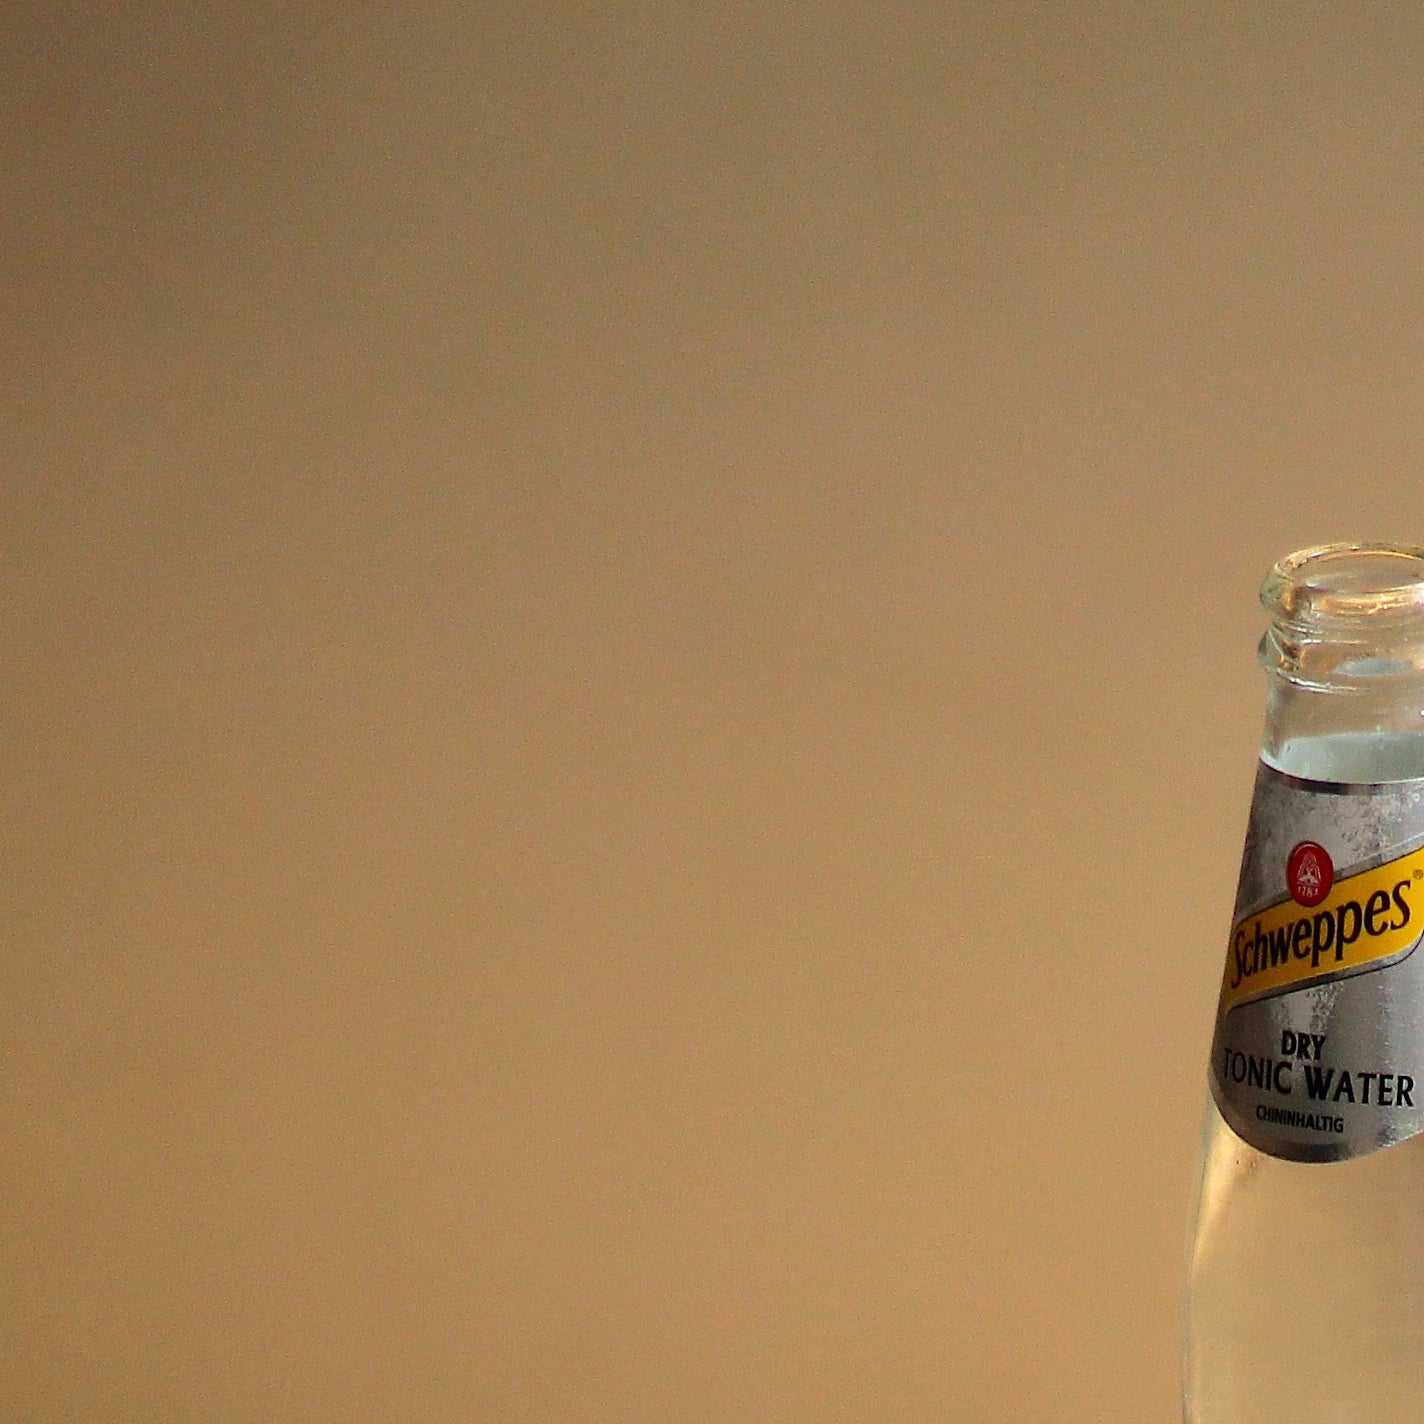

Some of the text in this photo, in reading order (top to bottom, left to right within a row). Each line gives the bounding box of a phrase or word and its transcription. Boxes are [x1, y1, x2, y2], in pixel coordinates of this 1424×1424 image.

[1231, 880, 1412, 989] Schweppes
[1281, 1030, 1326, 1060] DRY
[1224, 1048, 1415, 1107] TONIC WATER
[1256, 1104, 1344, 1133] CHININHALTIG
